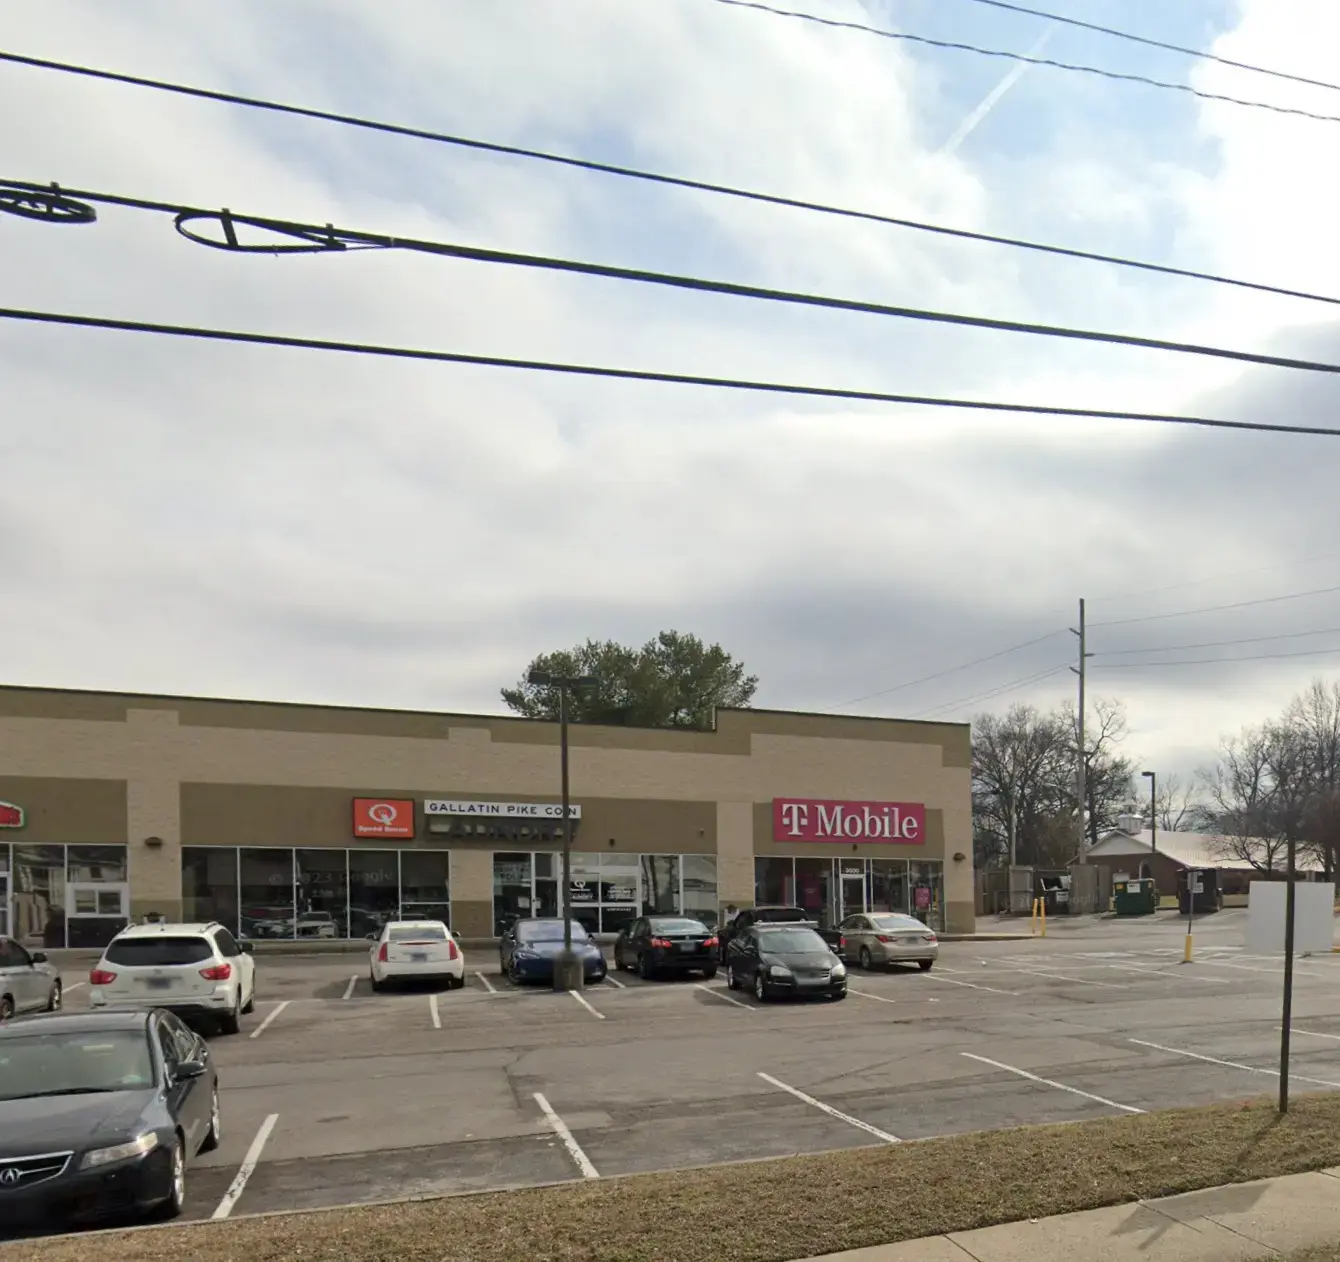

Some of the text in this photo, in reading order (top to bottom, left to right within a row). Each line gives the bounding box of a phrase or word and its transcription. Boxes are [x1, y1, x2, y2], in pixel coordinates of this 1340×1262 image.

[429, 803, 577, 816] GALLATIN PIKE CON
[815, 804, 918, 838] Mobile
